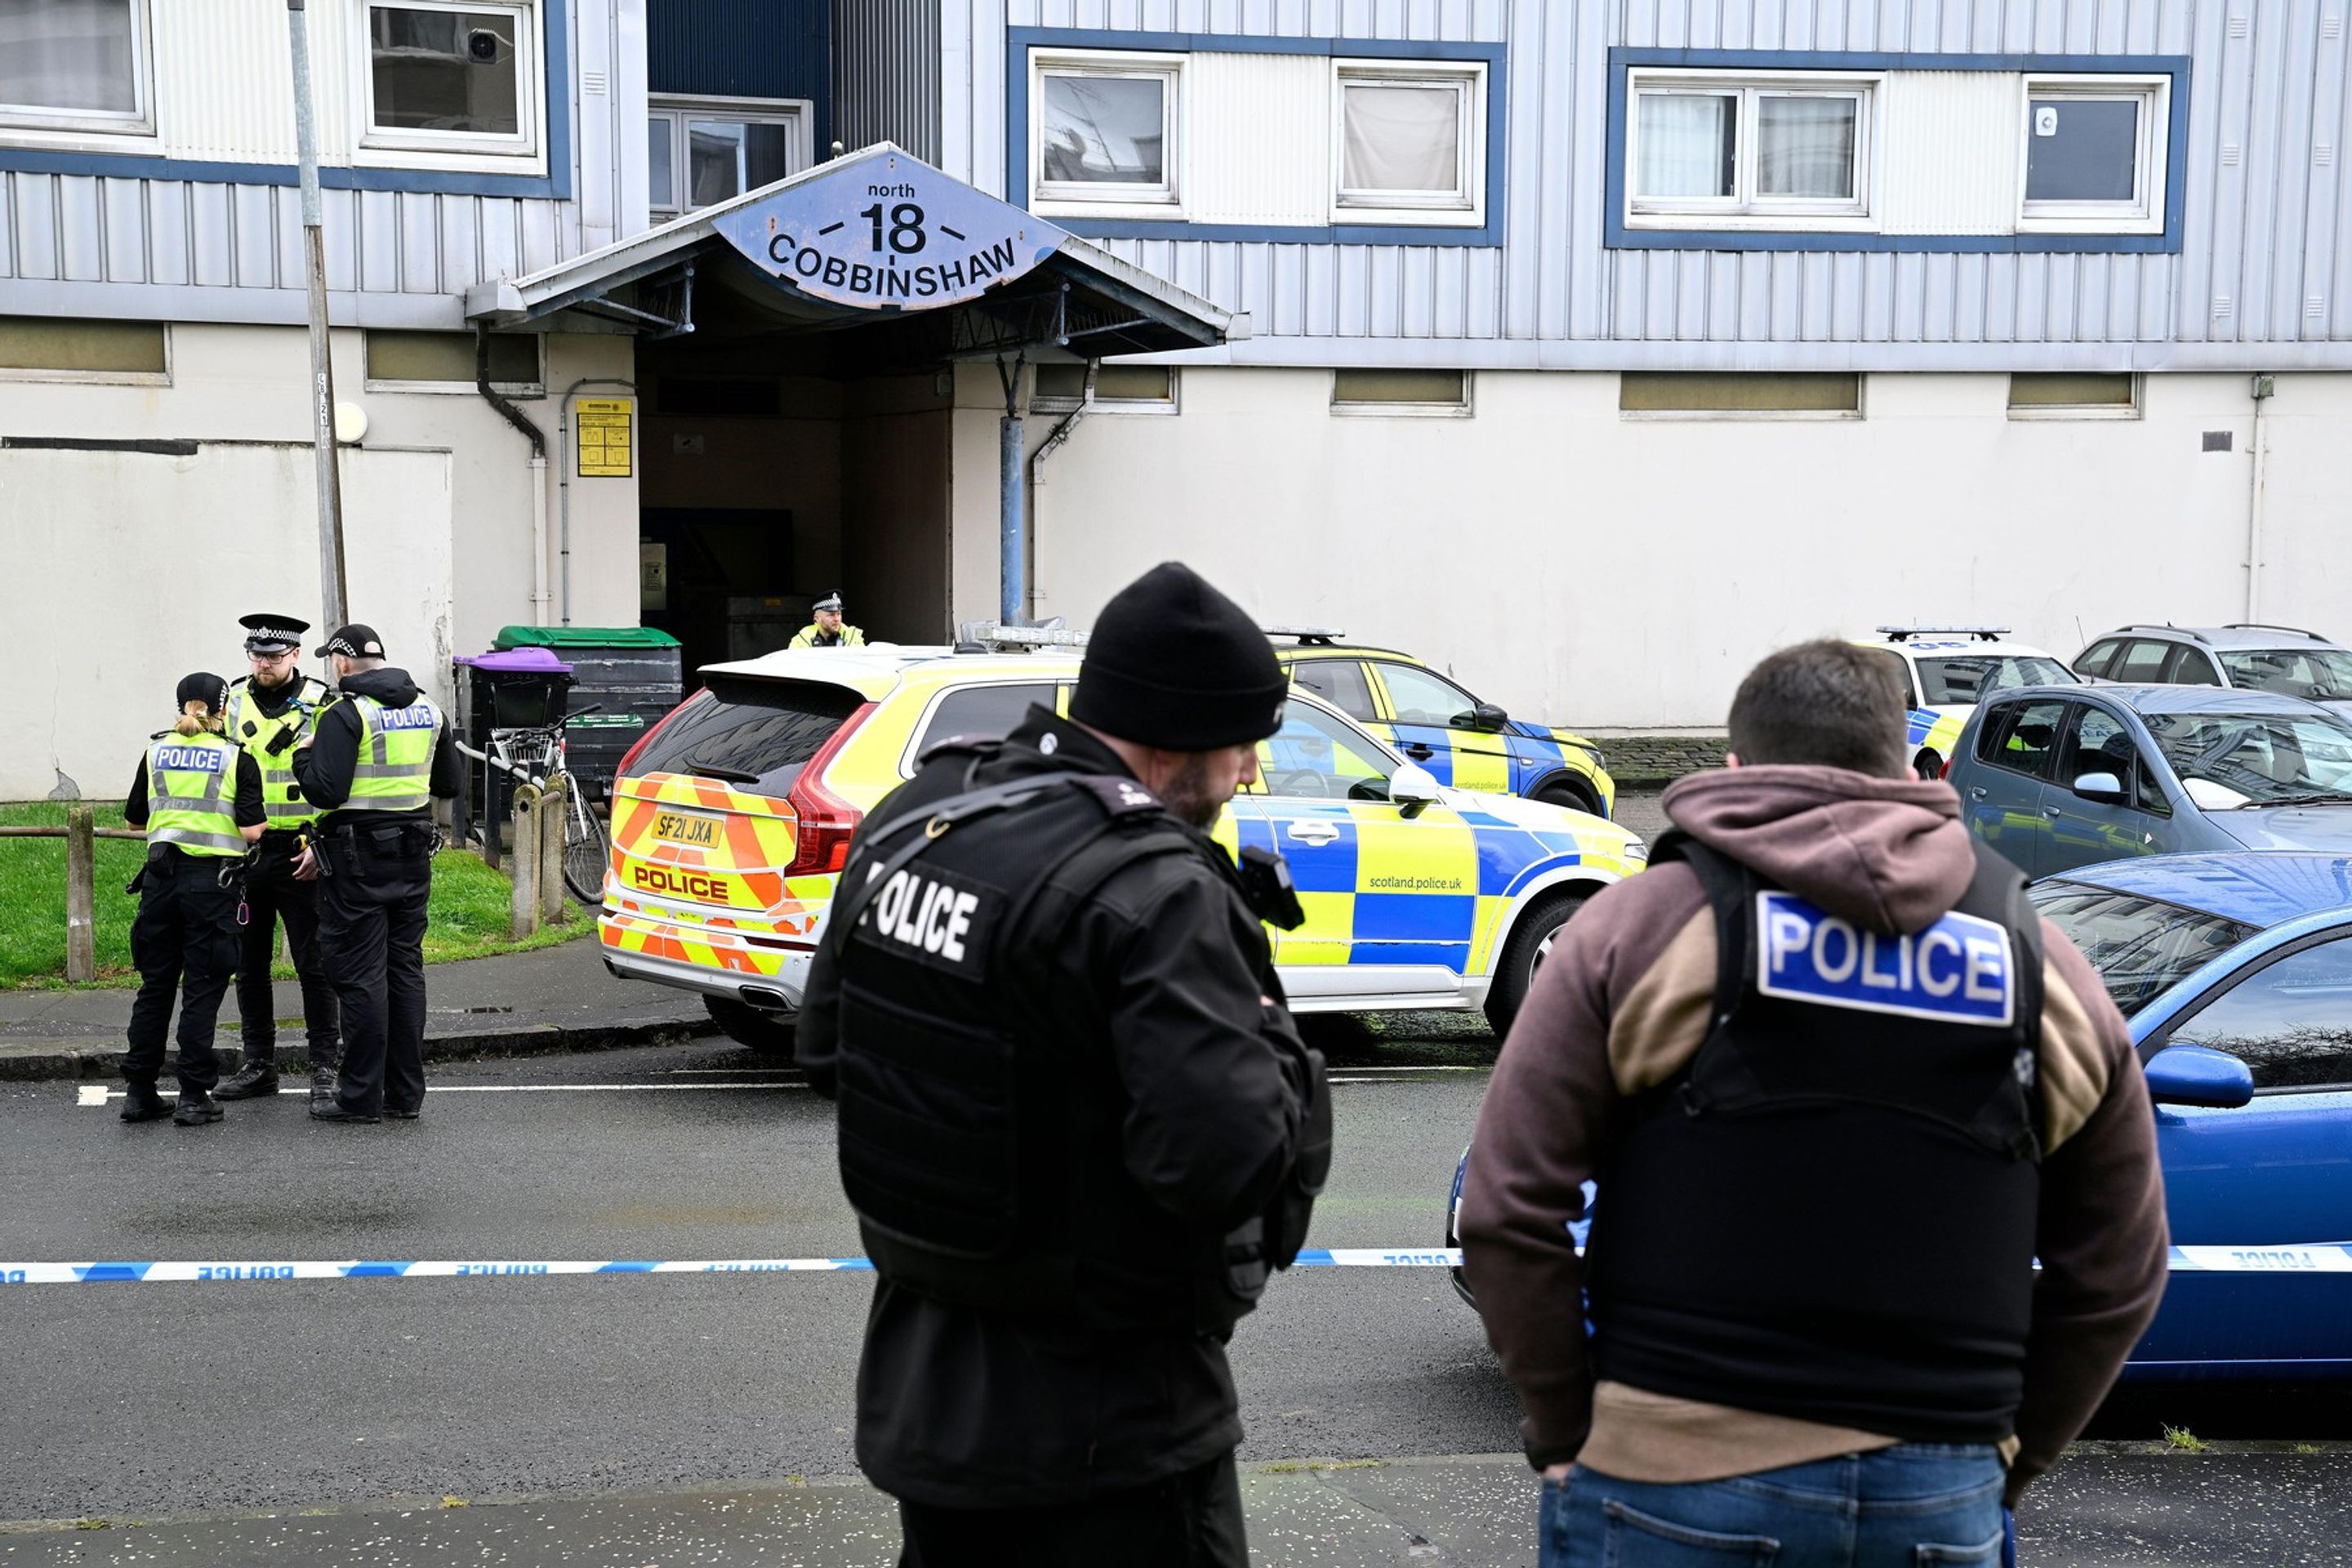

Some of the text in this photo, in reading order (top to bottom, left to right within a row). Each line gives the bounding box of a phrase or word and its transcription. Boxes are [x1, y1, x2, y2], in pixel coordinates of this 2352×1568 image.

[868, 183, 915, 198] north
[860, 203, 927, 255] 18
[768, 233, 1016, 298] COBBINSHAW
[381, 708, 432, 728] POLICE
[158, 748, 220, 769] POLICE
[657, 814, 713, 844] SF21 JXA
[635, 866, 729, 900] POLICE
[1370, 875, 1463, 891] scotland.police.uk
[1770, 912, 2004, 1002] POLICE
